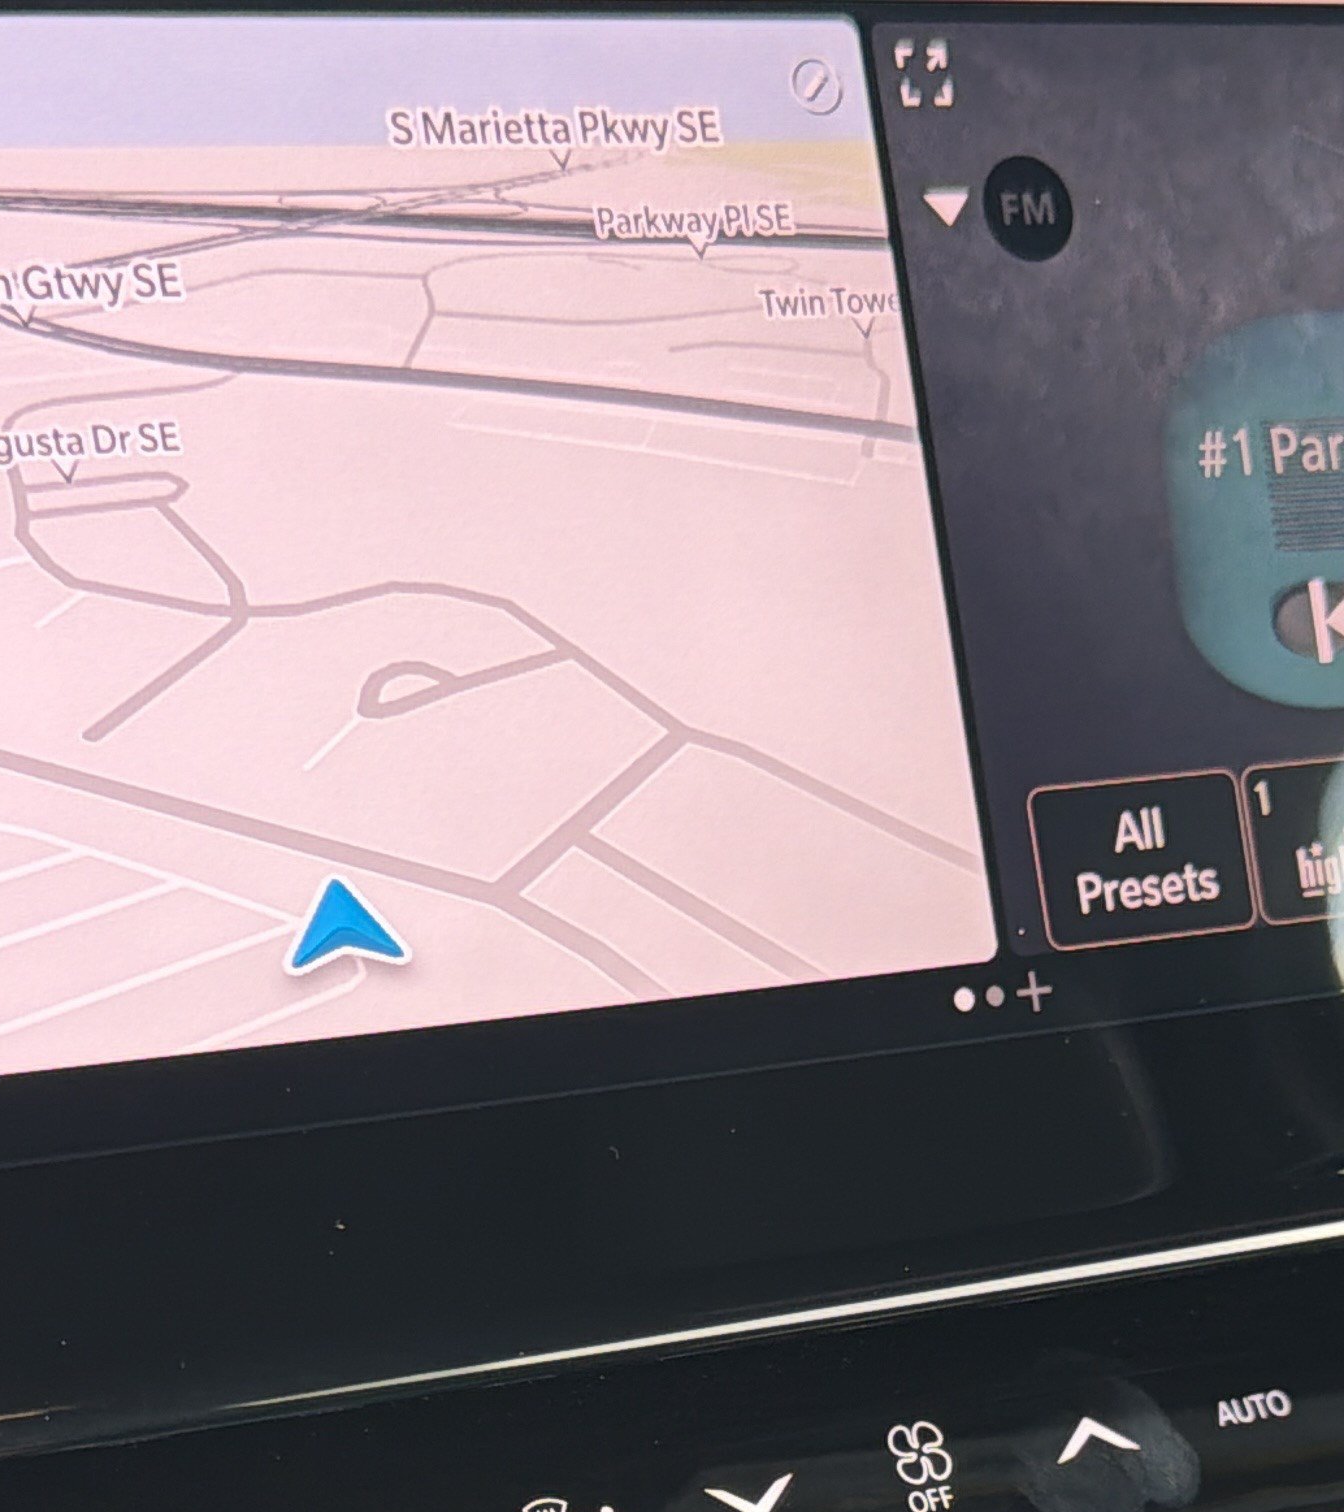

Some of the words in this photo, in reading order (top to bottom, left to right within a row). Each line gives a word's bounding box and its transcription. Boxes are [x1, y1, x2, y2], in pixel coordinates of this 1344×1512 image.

[390, 111, 413, 143] S
[422, 111, 569, 146] Marietta
[579, 111, 670, 148] Pkwy
[678, 109, 720, 142] SE
[597, 205, 717, 240] Parkway
[756, 203, 792, 231] SE
[1000, 189, 1055, 226] FM
[21, 263, 124, 306] Gtwy
[132, 262, 182, 299] SE
[758, 287, 825, 317] Twin
[91, 425, 133, 458] Dr
[139, 422, 180, 454] SE
[1199, 428, 1251, 478] #1
[1253, 779, 1272, 816] 1
[1114, 806, 1164, 852] All
[1076, 862, 1220, 915] Presets
[1217, 1389, 1291, 1428] AUTO
